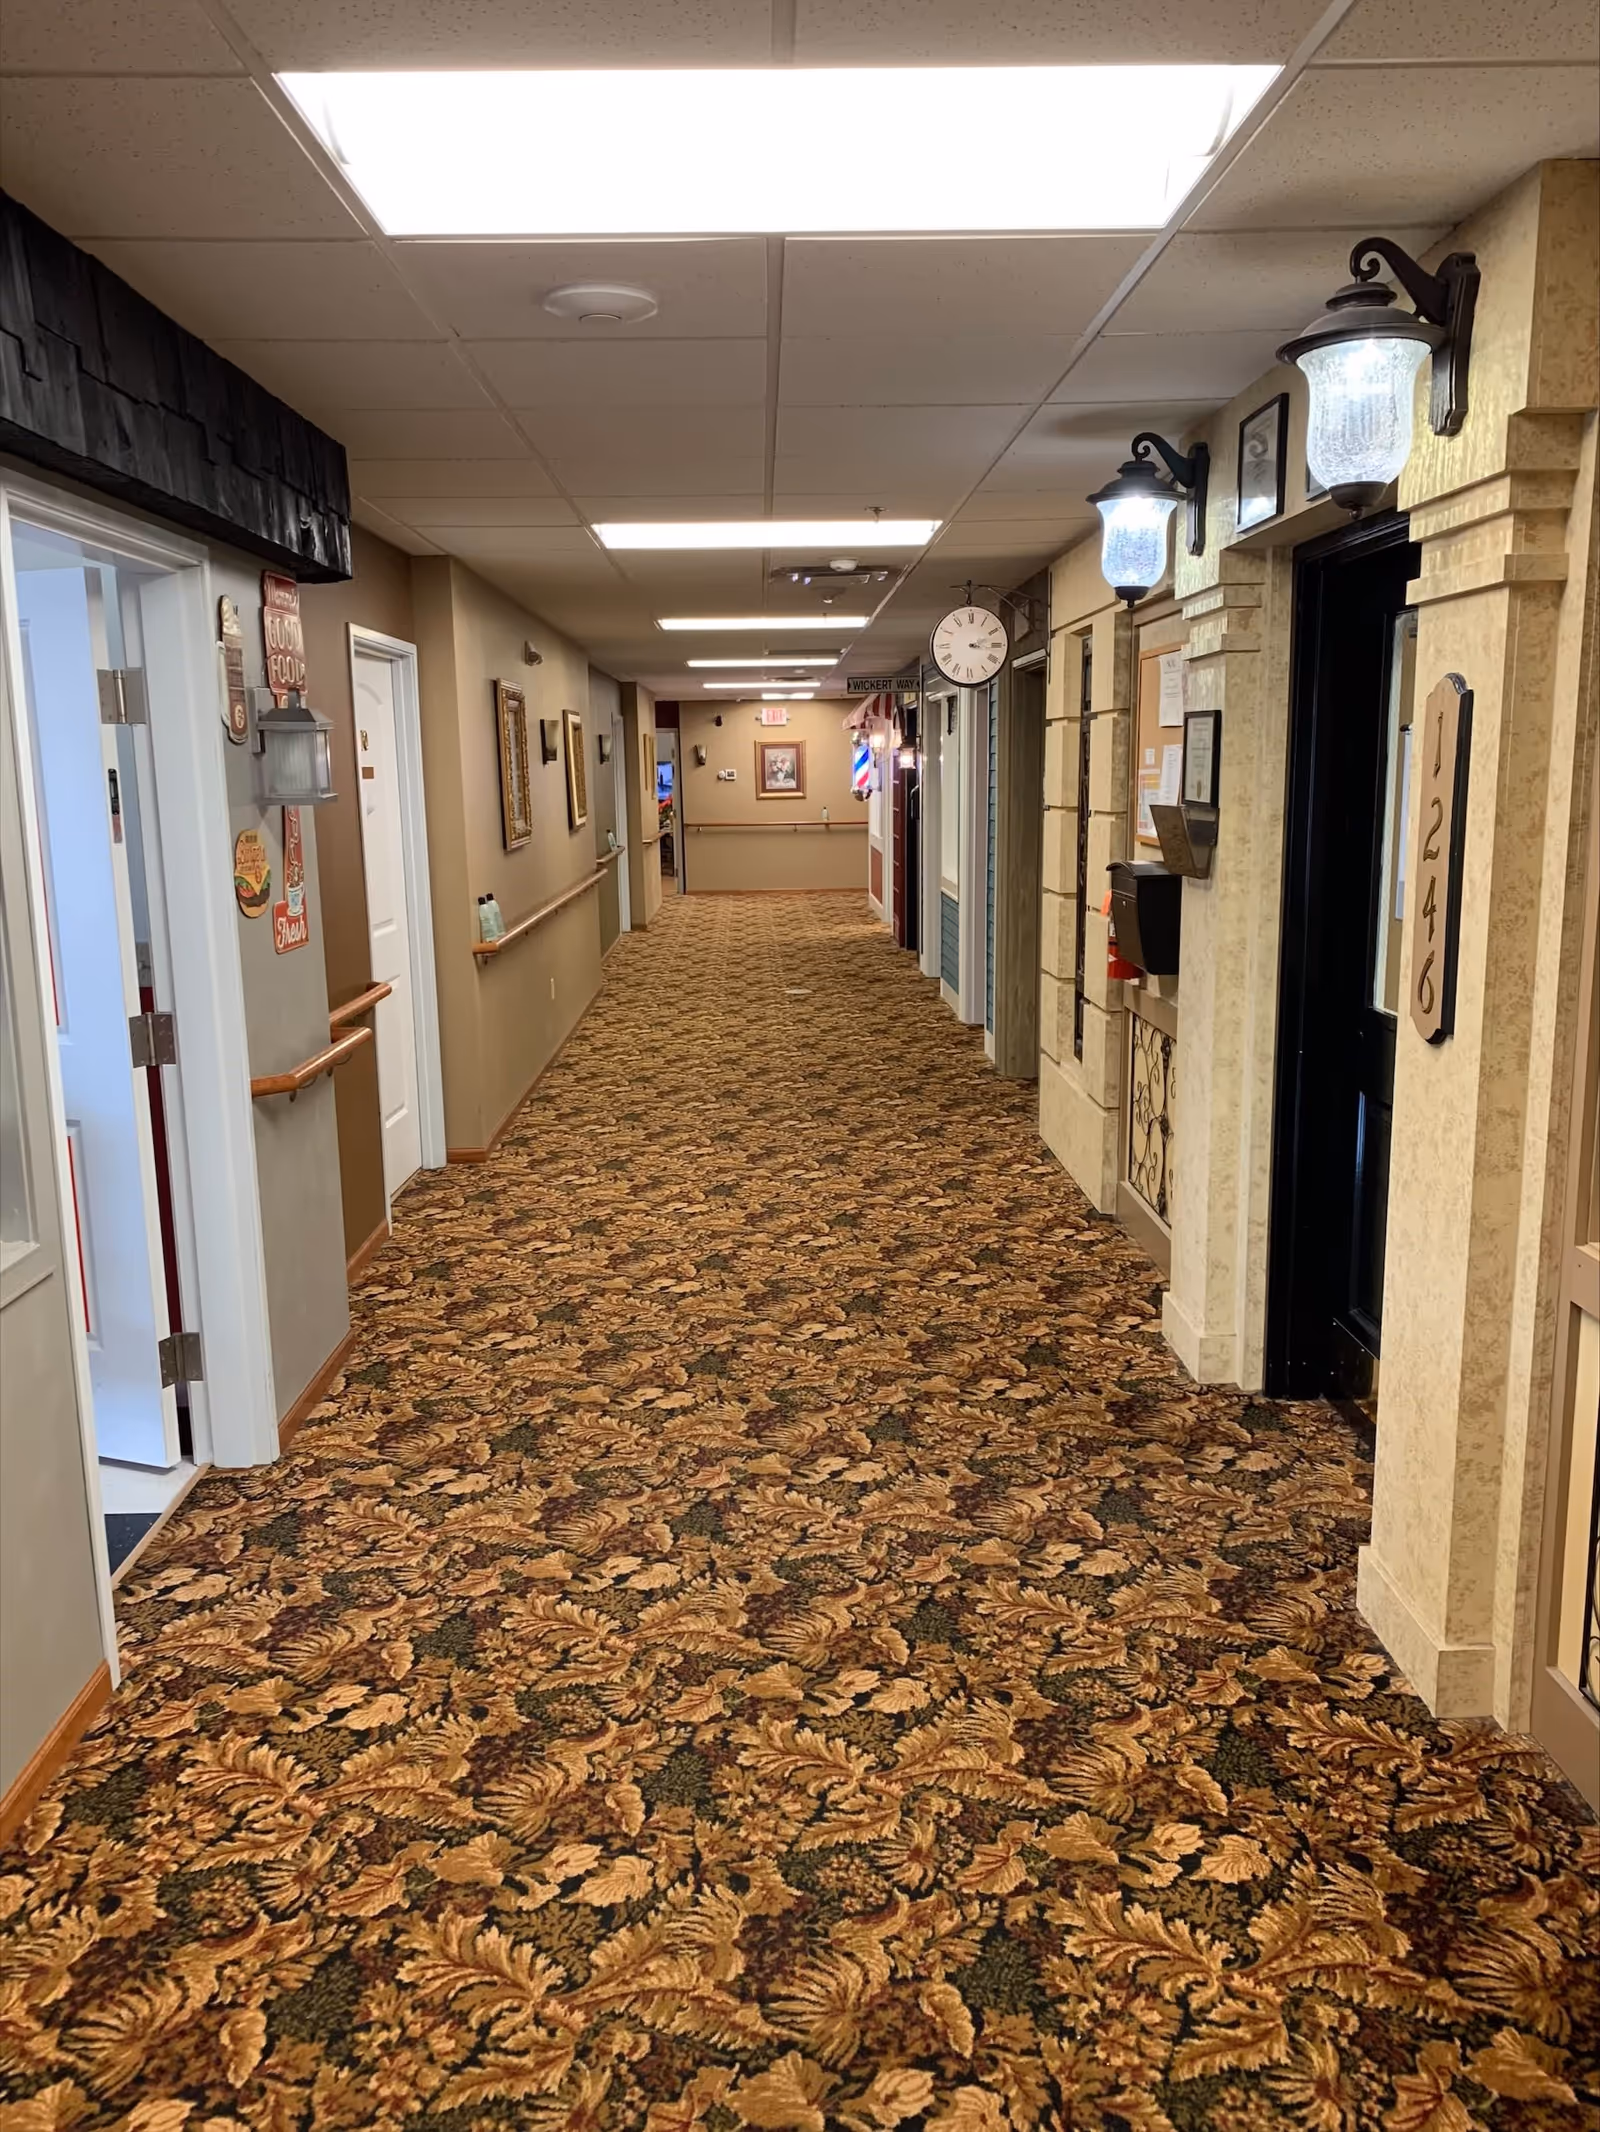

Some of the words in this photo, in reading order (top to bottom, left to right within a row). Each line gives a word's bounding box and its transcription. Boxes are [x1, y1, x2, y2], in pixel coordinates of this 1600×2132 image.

[267, 615, 302, 651] GOOD
[271, 654, 306, 685] FOOD
[853, 680, 892, 690] WICKERT
[896, 679, 916, 690] WAY
[766, 709, 783, 722] EXIT
[1417, 710, 1444, 1015] 1246
[277, 916, 307, 948] Fresh
